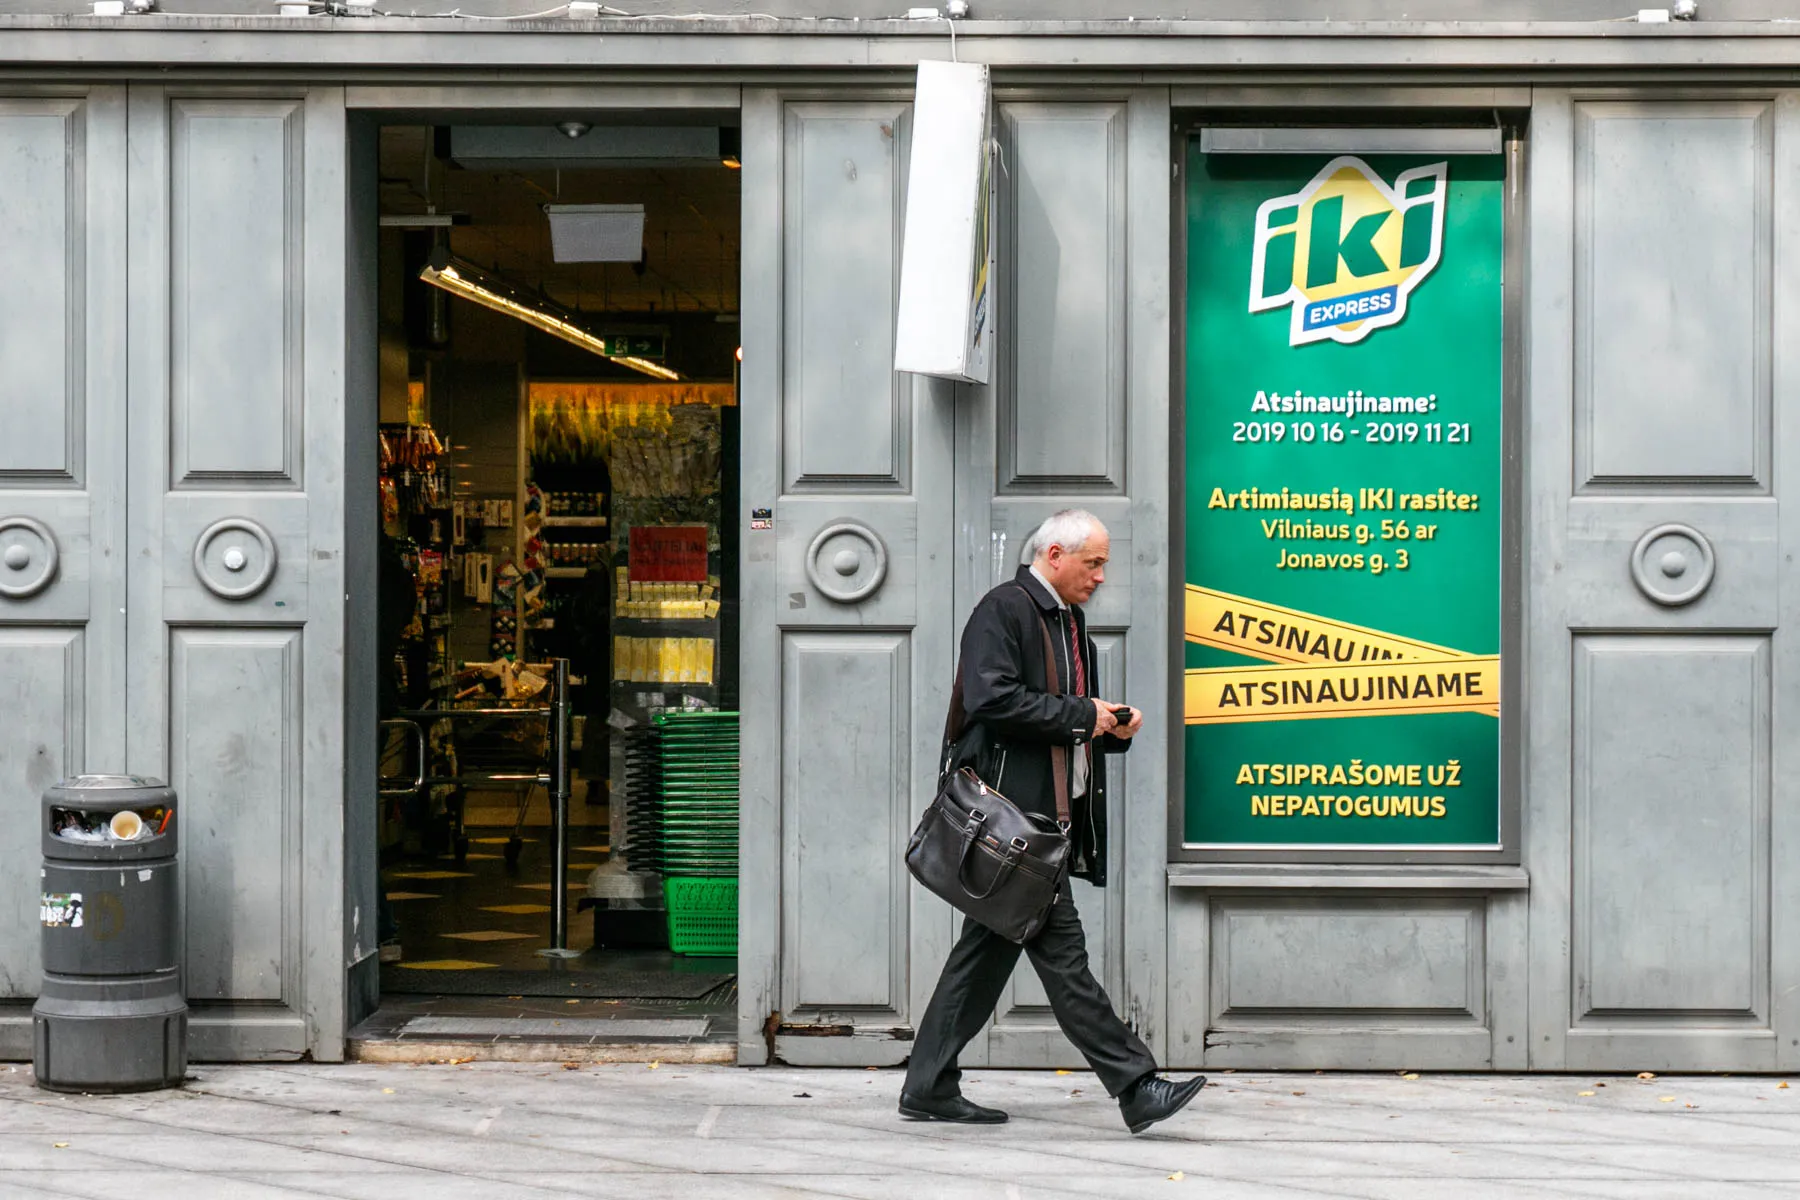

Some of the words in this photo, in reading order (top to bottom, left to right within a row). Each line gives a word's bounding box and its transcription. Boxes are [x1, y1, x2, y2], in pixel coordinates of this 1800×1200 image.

[1262, 173, 1435, 299] iki
[1310, 293, 1391, 324] EXPRESS
[1251, 390, 1436, 417] Atsinaujiname:
[1233, 422, 1285, 442] 2019
[1292, 422, 1315, 442] 10
[1321, 422, 1344, 442] 16
[1366, 422, 1418, 442] 2019
[1424, 423, 1441, 442] 11
[1447, 422, 1469, 442] 21
[1208, 487, 1353, 514] Artimiausią
[1359, 487, 1393, 510] IKI
[1399, 487, 1478, 510] rasite:
[1261, 518, 1350, 539] Vilniaus
[1355, 524, 1375, 544] g.
[1381, 519, 1410, 539] 56
[1415, 524, 1437, 539] ar
[1276, 548, 1364, 569] Jonavos
[1370, 553, 1389, 574] g.
[1395, 549, 1409, 569] 3
[1219, 672, 1483, 708] ATSINAUJINAME
[1236, 759, 1422, 786] ATSIPRAŠOME
[1427, 759, 1461, 786] UŽ
[1252, 795, 1446, 817] NEPATOGUMUS
